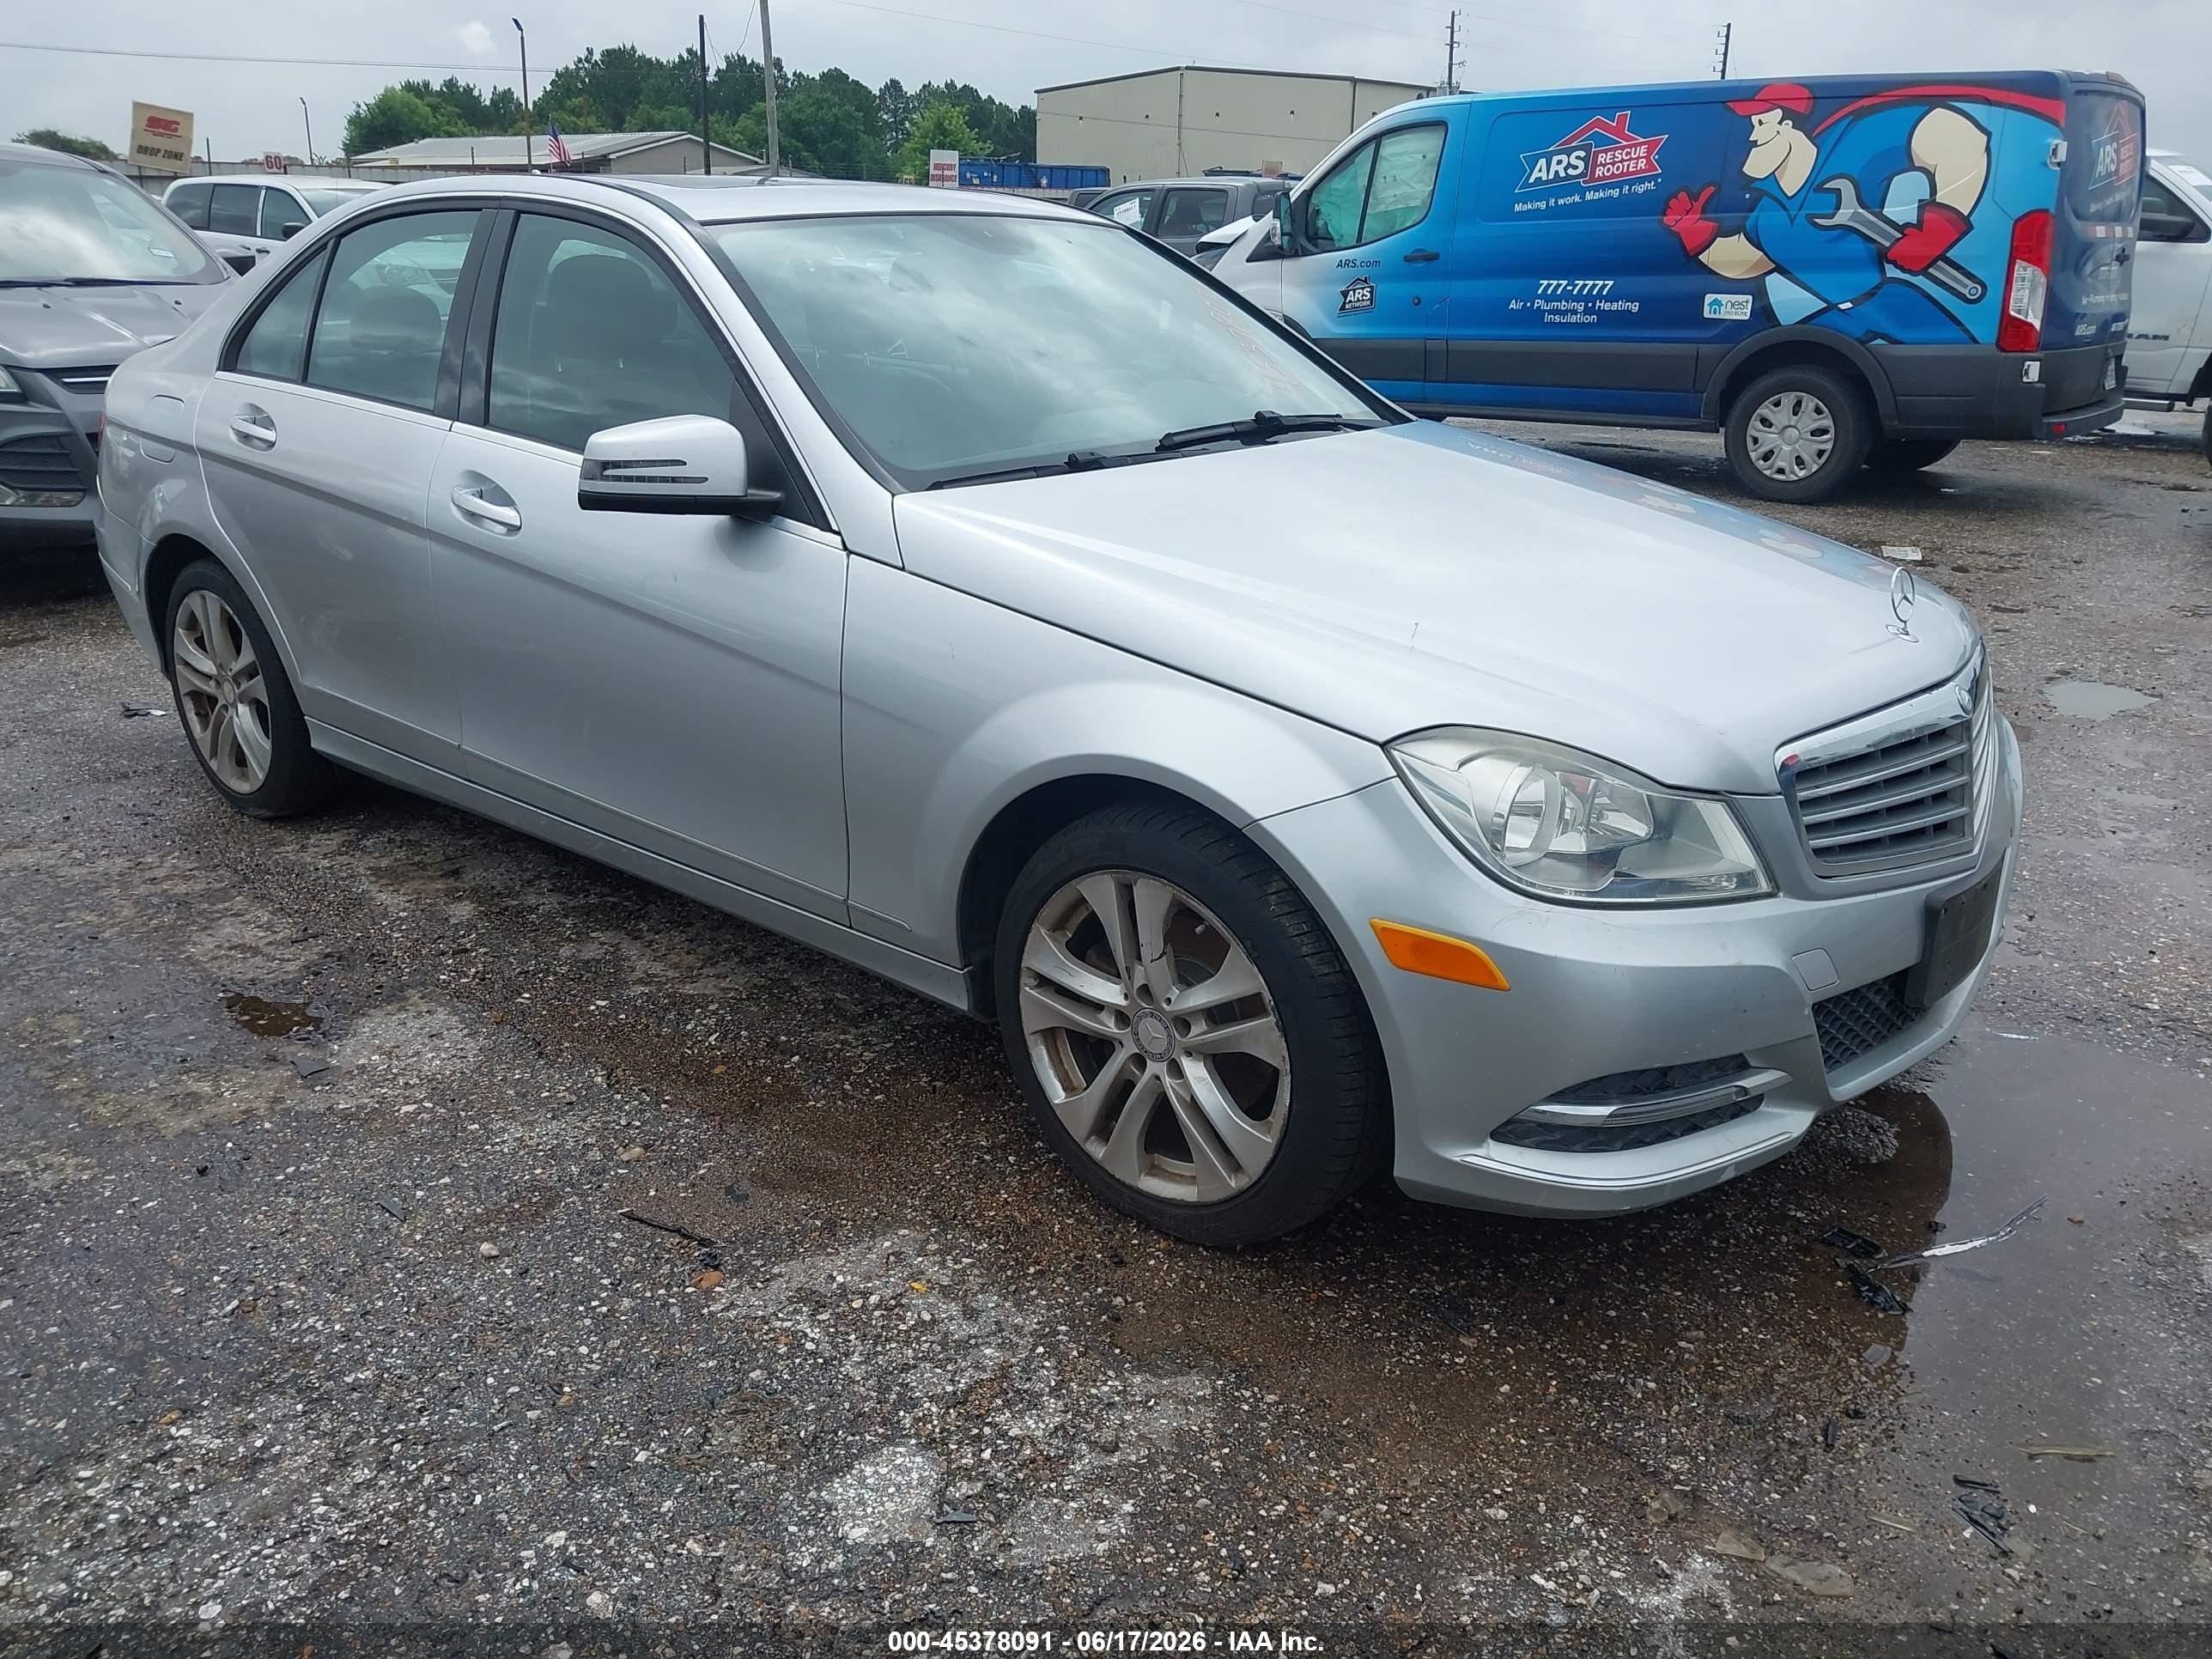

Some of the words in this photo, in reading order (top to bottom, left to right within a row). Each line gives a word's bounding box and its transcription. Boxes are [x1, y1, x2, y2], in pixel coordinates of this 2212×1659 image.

[137, 145, 161, 157] DROP
[161, 149, 185, 161] ZONE
[1596, 144, 1649, 165] RESCUE
[2095, 142, 2118, 179] ARS
[264, 155, 283, 170] 60
[1528, 150, 1587, 184] ARS
[1595, 159, 1647, 179] ROOTER
[1514, 198, 1547, 212] Making
[1549, 197, 1556, 207] it
[1557, 193, 1582, 206] work.
[1585, 186, 1620, 202] Making
[1622, 185, 1629, 197] it
[1632, 180, 1656, 196] right.
[1336, 258, 1382, 269] ARS.com
[1346, 288, 1371, 302] ARS
[1537, 280, 1615, 295] 777-7777
[1345, 300, 1371, 309] NETWORK
[1509, 299, 1524, 310] Air
[1533, 299, 1585, 313] Plumbing
[1595, 300, 1639, 313] Heating
[1724, 298, 1750, 311] nest
[1544, 313, 1597, 323] Insulation
